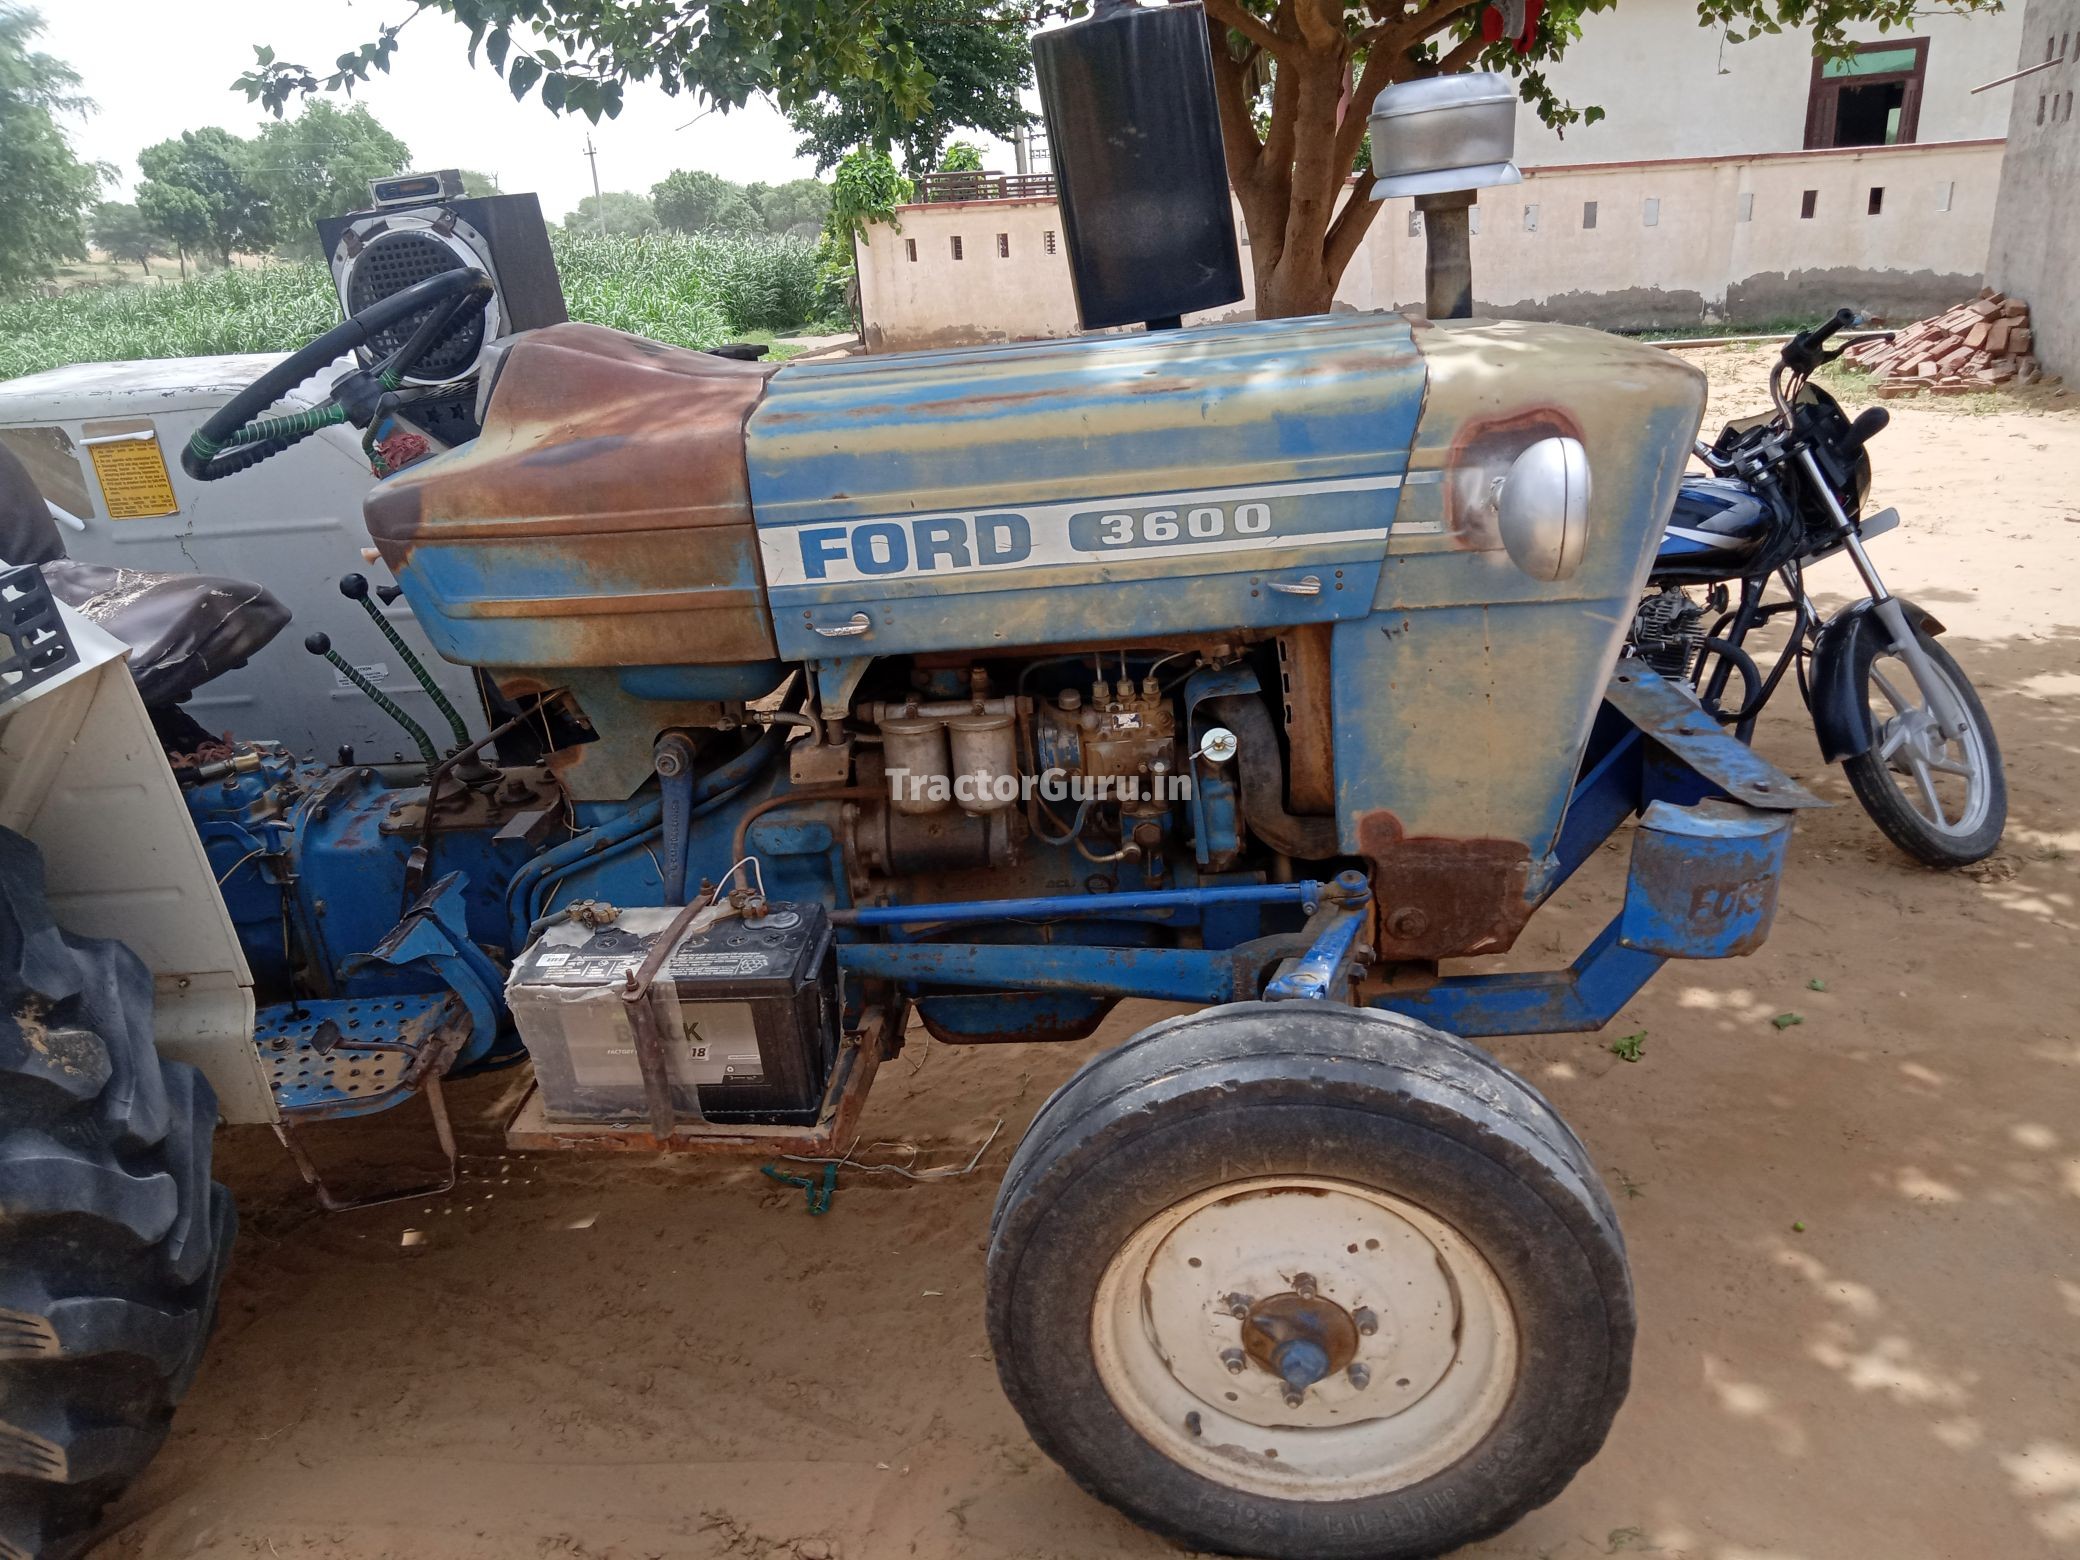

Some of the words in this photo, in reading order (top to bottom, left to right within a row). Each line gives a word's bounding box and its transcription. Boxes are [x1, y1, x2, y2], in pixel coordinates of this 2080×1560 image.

[799, 513, 1032, 580] FORD
[1100, 502, 1272, 546] 3600
[691, 1047, 706, 1058] 18
